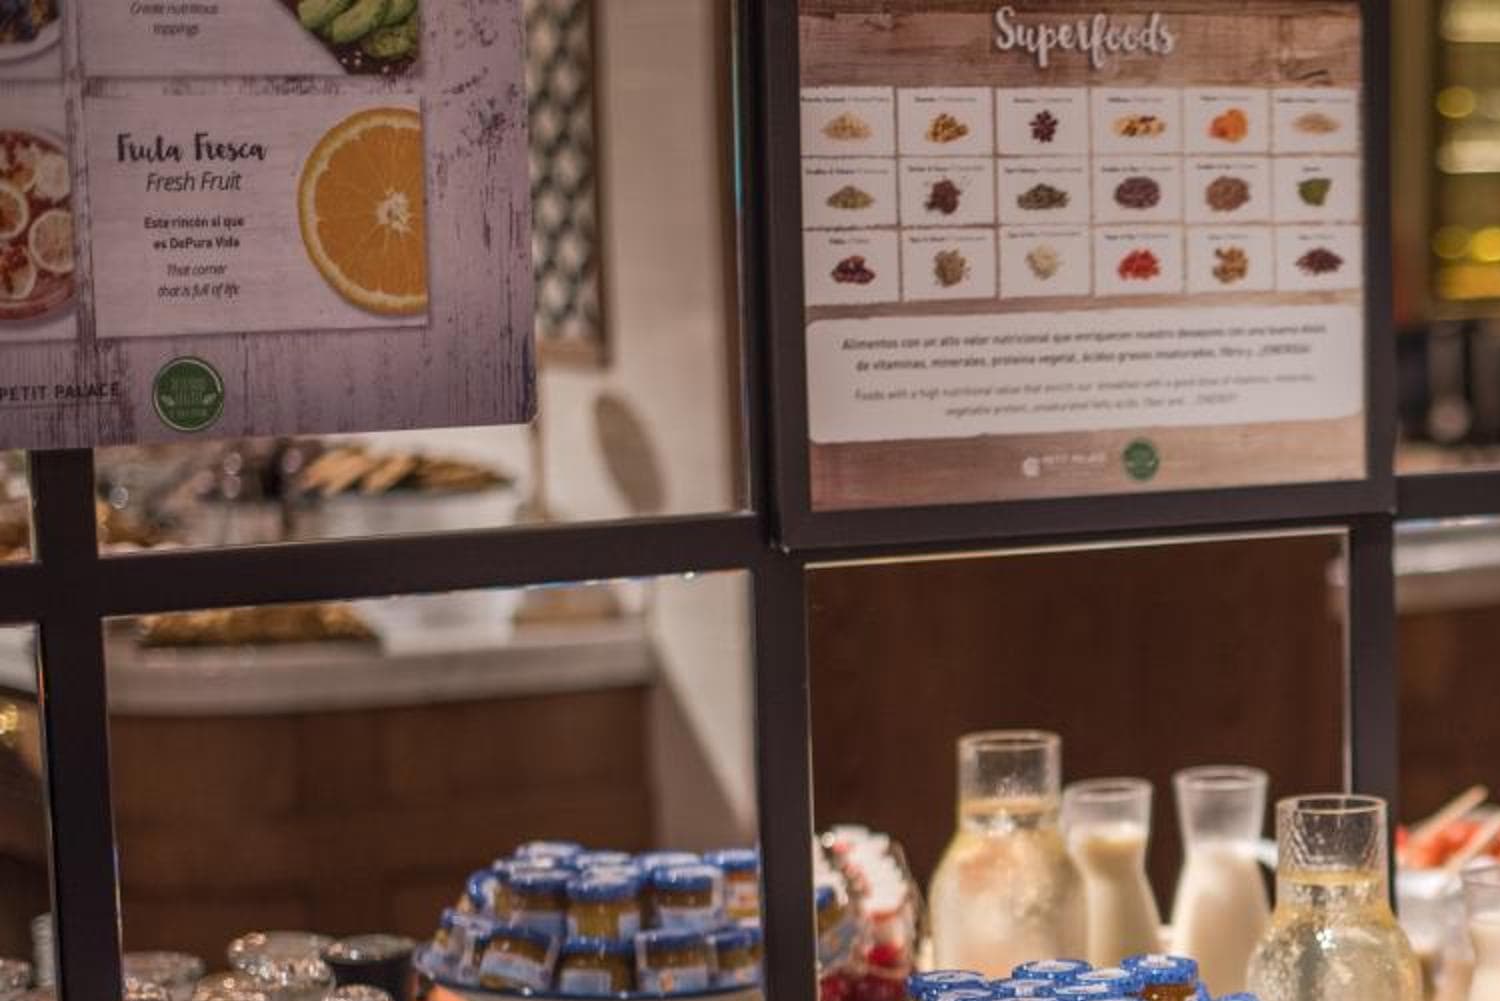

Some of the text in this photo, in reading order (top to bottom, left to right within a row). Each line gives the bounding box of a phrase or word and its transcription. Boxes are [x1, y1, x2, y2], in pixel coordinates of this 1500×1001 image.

[995, 6, 1176, 69] Superfoods
[194, 131, 269, 162] Fresca
[146, 170, 243, 192] Fresh Fruit
[144, 216, 169, 229] Este
[223, 216, 245, 231] que
[153, 239, 167, 250] es
[55, 382, 120, 400] PALACE
